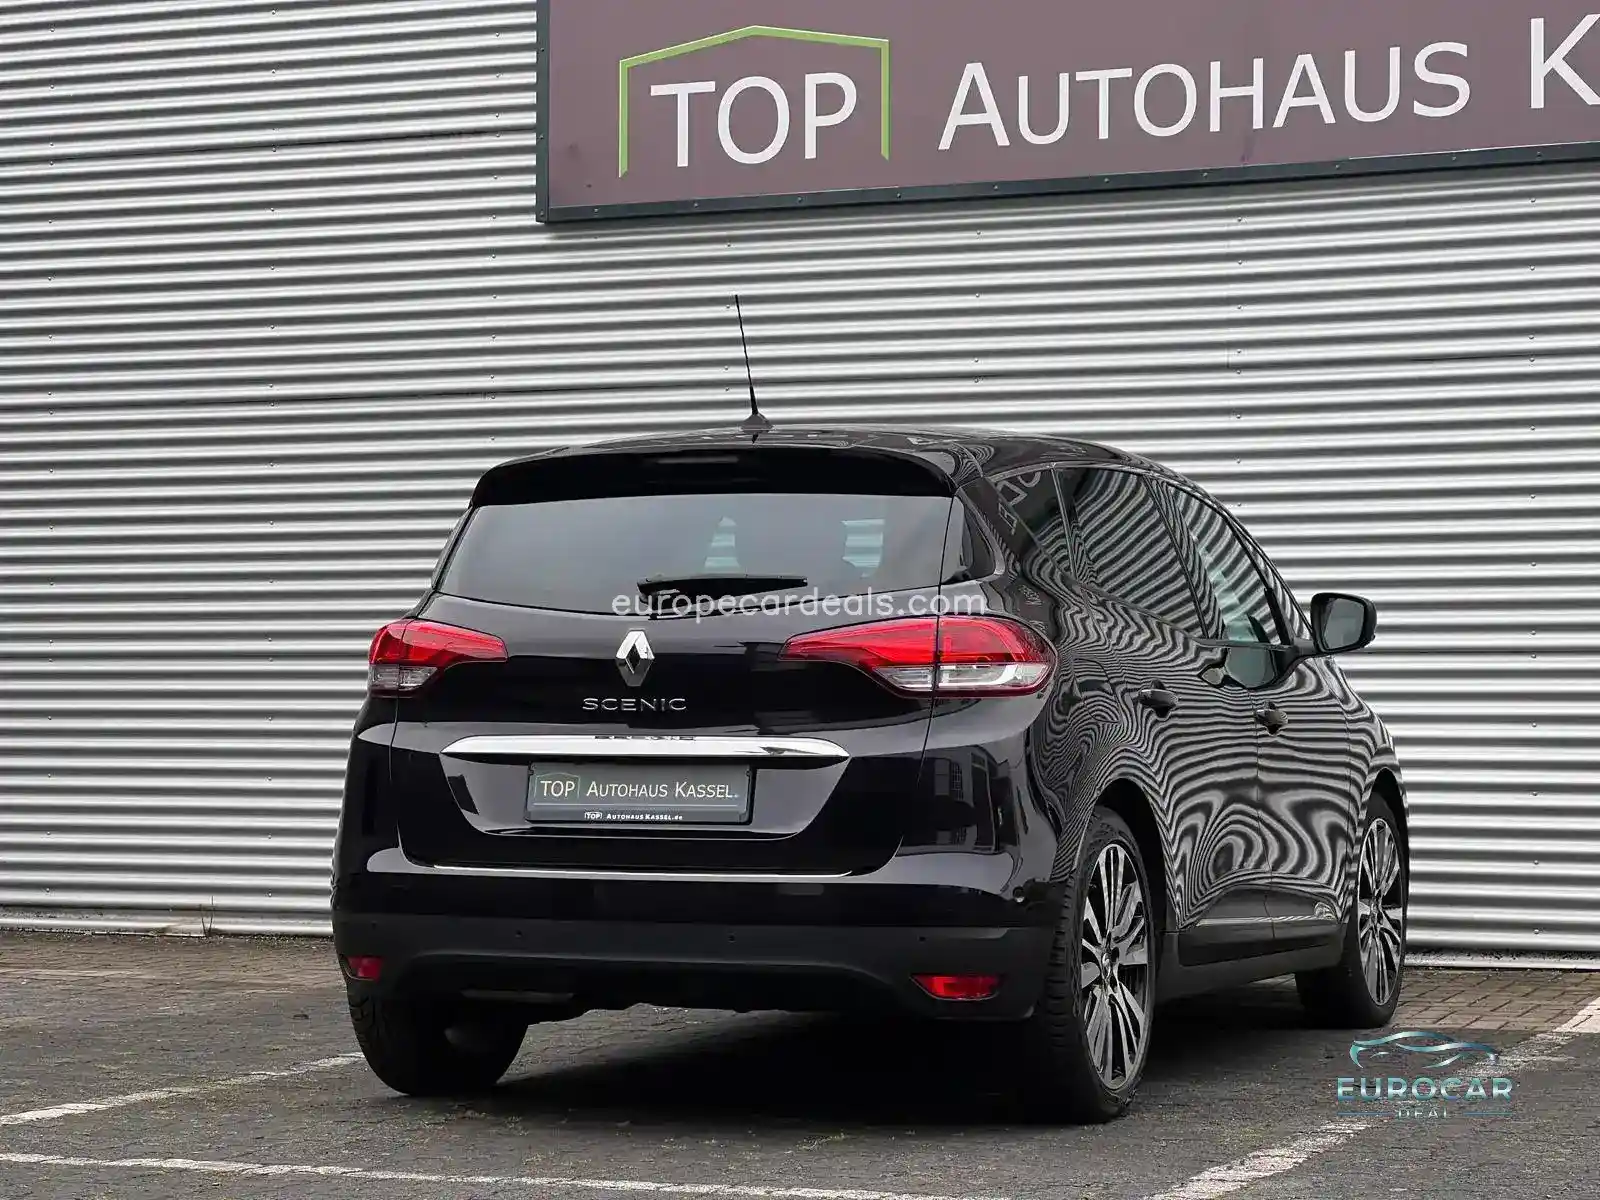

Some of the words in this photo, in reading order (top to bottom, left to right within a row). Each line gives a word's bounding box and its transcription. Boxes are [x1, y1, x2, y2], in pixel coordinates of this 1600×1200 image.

[650, 72, 858, 168] TOP
[938, 41, 1471, 151] AUTOHAUS
[582, 697, 687, 711] SCENIC
[540, 780, 576, 797] TOP
[586, 781, 668, 798] AUTOHAUS
